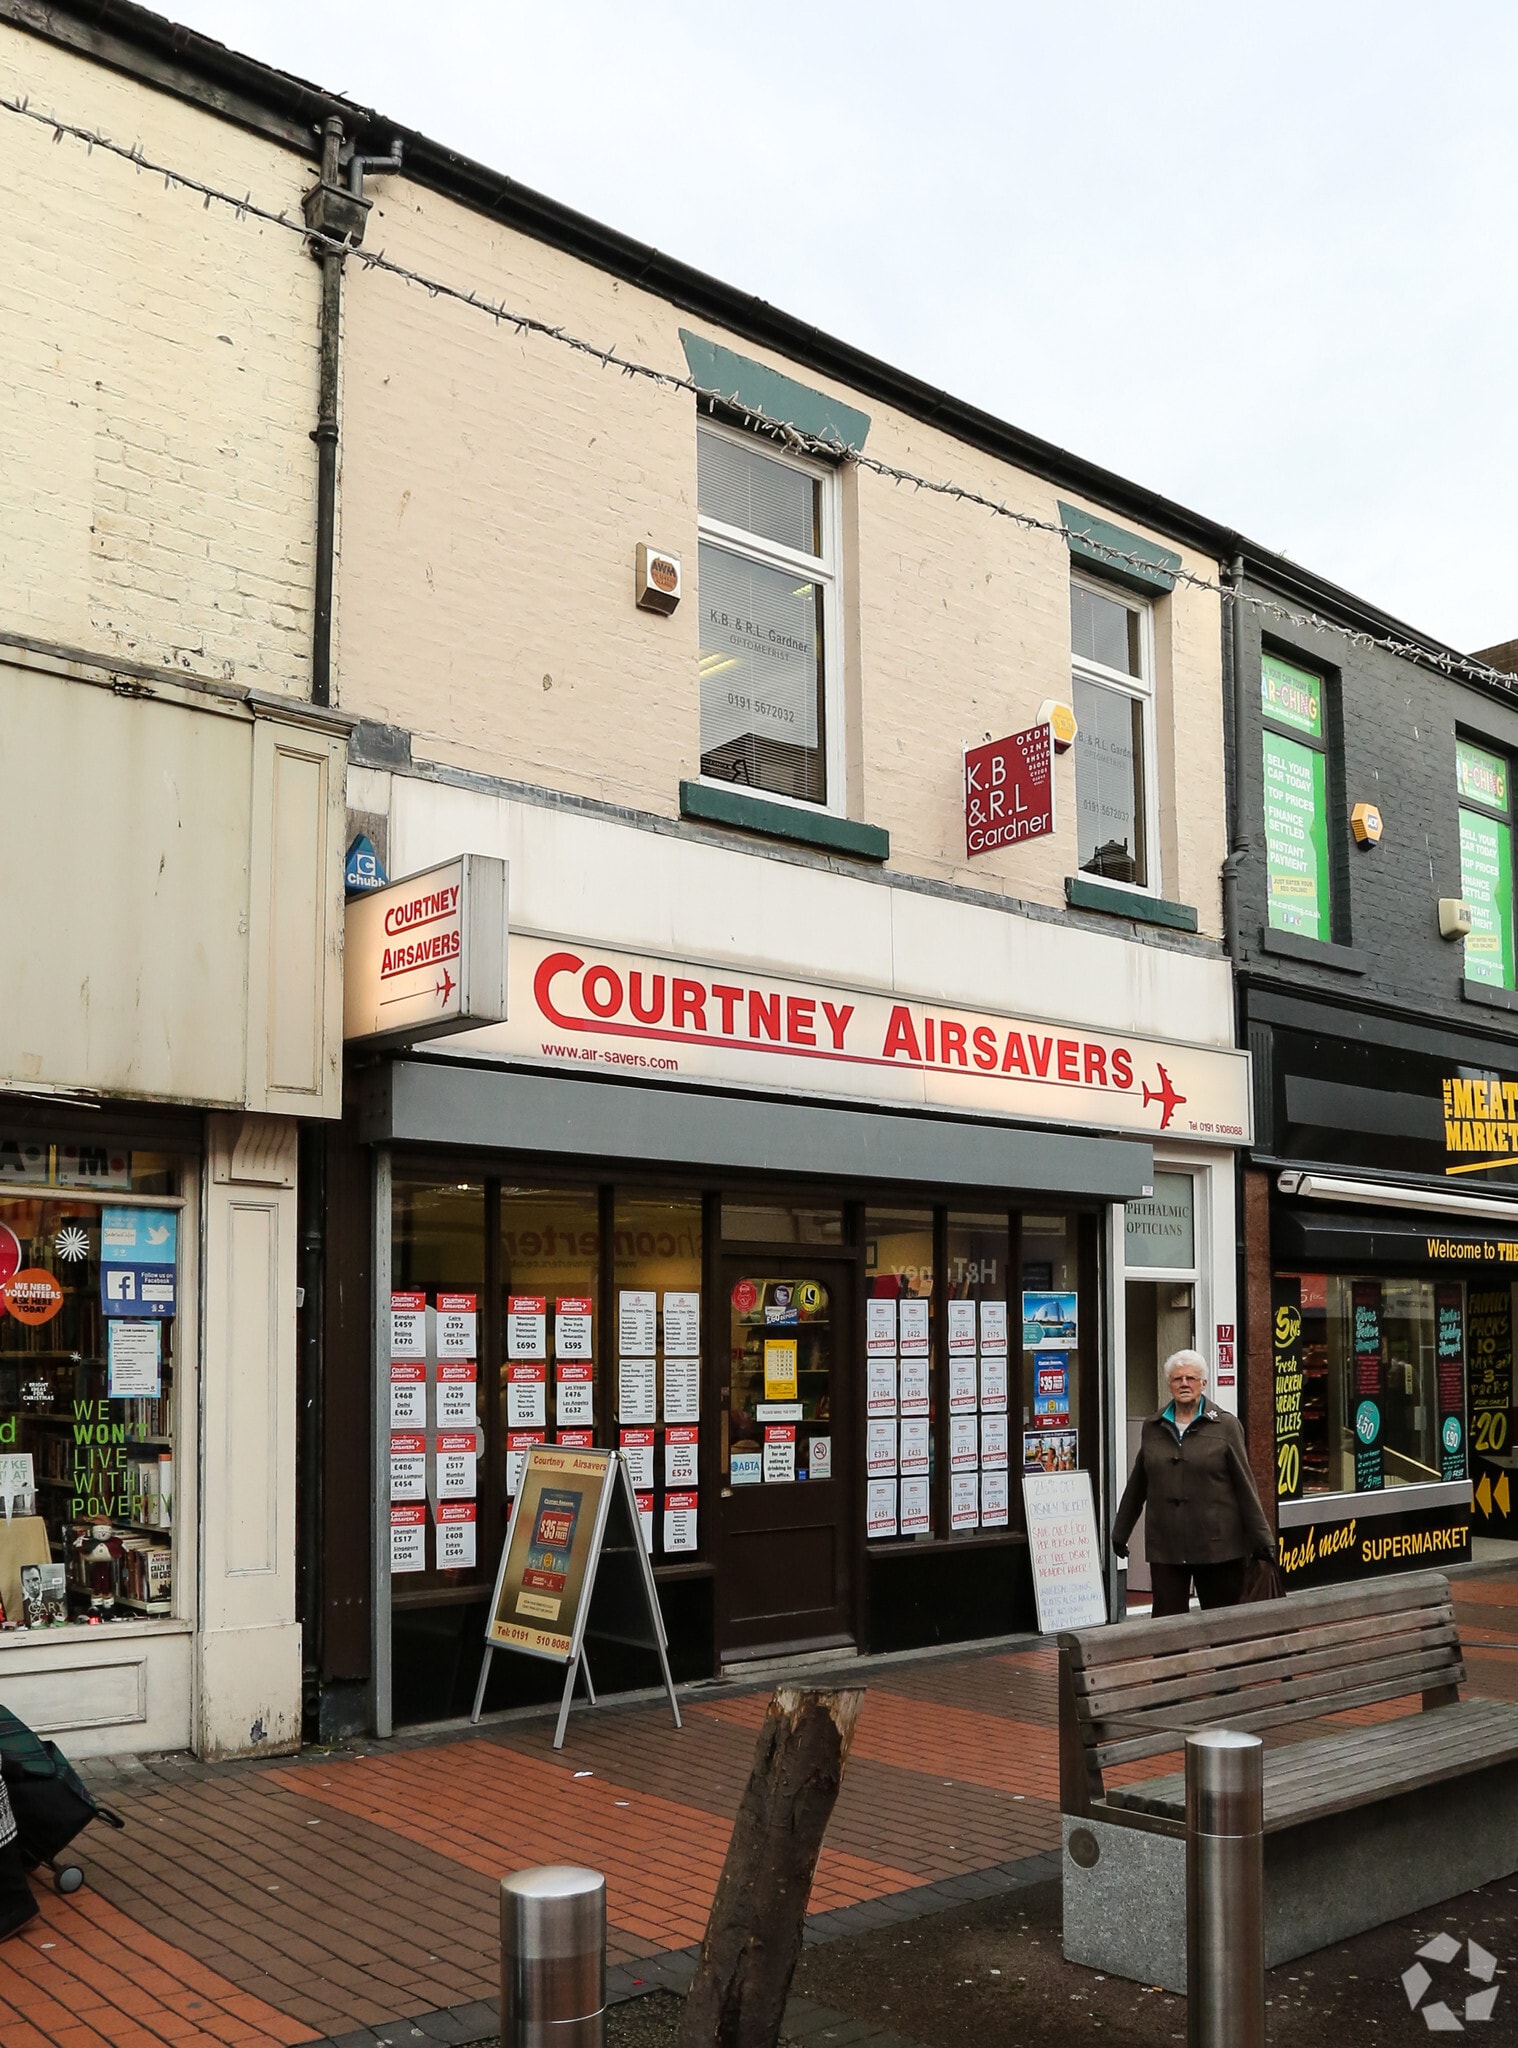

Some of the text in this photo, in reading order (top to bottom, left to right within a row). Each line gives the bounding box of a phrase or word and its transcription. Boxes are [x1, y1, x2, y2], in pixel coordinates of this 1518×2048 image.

[735, 618, 743, 631] &
[769, 630, 808, 653] Gardner
[728, 693, 795, 722] 0191 5672032
[967, 756, 1007, 794] K.B
[1267, 753, 1311, 779] SELL YOUR
[1267, 767, 1311, 792] CAR TODAY
[1268, 786, 1314, 811] TOP PRICES
[1268, 806, 1304, 827] FINANCE
[968, 812, 1050, 850] Gardner
[1268, 820, 1305, 840] SETTLED
[1461, 828, 1497, 849] SELL YOUR
[1269, 839, 1305, 859] INSTANT
[1461, 840, 1497, 859] CAR TODAY
[1270, 852, 1308, 872] PAYMENT
[1461, 857, 1499, 876] TOP PRICES
[347, 872, 386, 888] Chubb
[1461, 874, 1490, 891] FINANCE
[1462, 886, 1491, 902] SETTLED
[385, 885, 460, 936] COURTNEY
[381, 930, 460, 975] AIRSAVERS
[533, 952, 1134, 1090] COURTNEY AIRSAVERS
[541, 1042, 679, 1071] www.air-savers.com
[1443, 1078, 1453, 1119] THE
[1452, 1078, 1518, 1120] MEAT
[1188, 1121, 1198, 1131] Tel
[1200, 1122, 1214, 1132] 0191
[1445, 1121, 1518, 1151] MARKET
[1127, 1222, 1183, 1236] OPTICIANS
[1427, 1239, 1518, 1261] Welcome to THE
[5, 1289, 61, 1299] VOLUNTEERS
[15, 1283, 52, 1291] WE NEED
[1468, 1293, 1510, 1315] FAMILY
[1221, 1326, 1231, 1338] 17
[1469, 1316, 1509, 1337] PACKS
[1483, 1369, 1495, 1383] 3
[73, 1400, 110, 1420] WE
[73, 1423, 148, 1445] WON'T
[74, 1448, 128, 1469] LIVE
[534, 1455, 607, 1471] Courtney Airsavers
[739, 1461, 760, 1470] ABTA
[73, 1471, 137, 1494] WITH
[672, 1469, 692, 1477] £529
[72, 1493, 172, 1519] POVERTY
[541, 1520, 555, 1539] $35
[1319, 1519, 1356, 1557] meat
[1362, 1526, 1469, 1563] SUPERMARKET
[28, 1601, 65, 1614] GARY
[497, 1625, 570, 1650] Tel: 0191 510 8088
